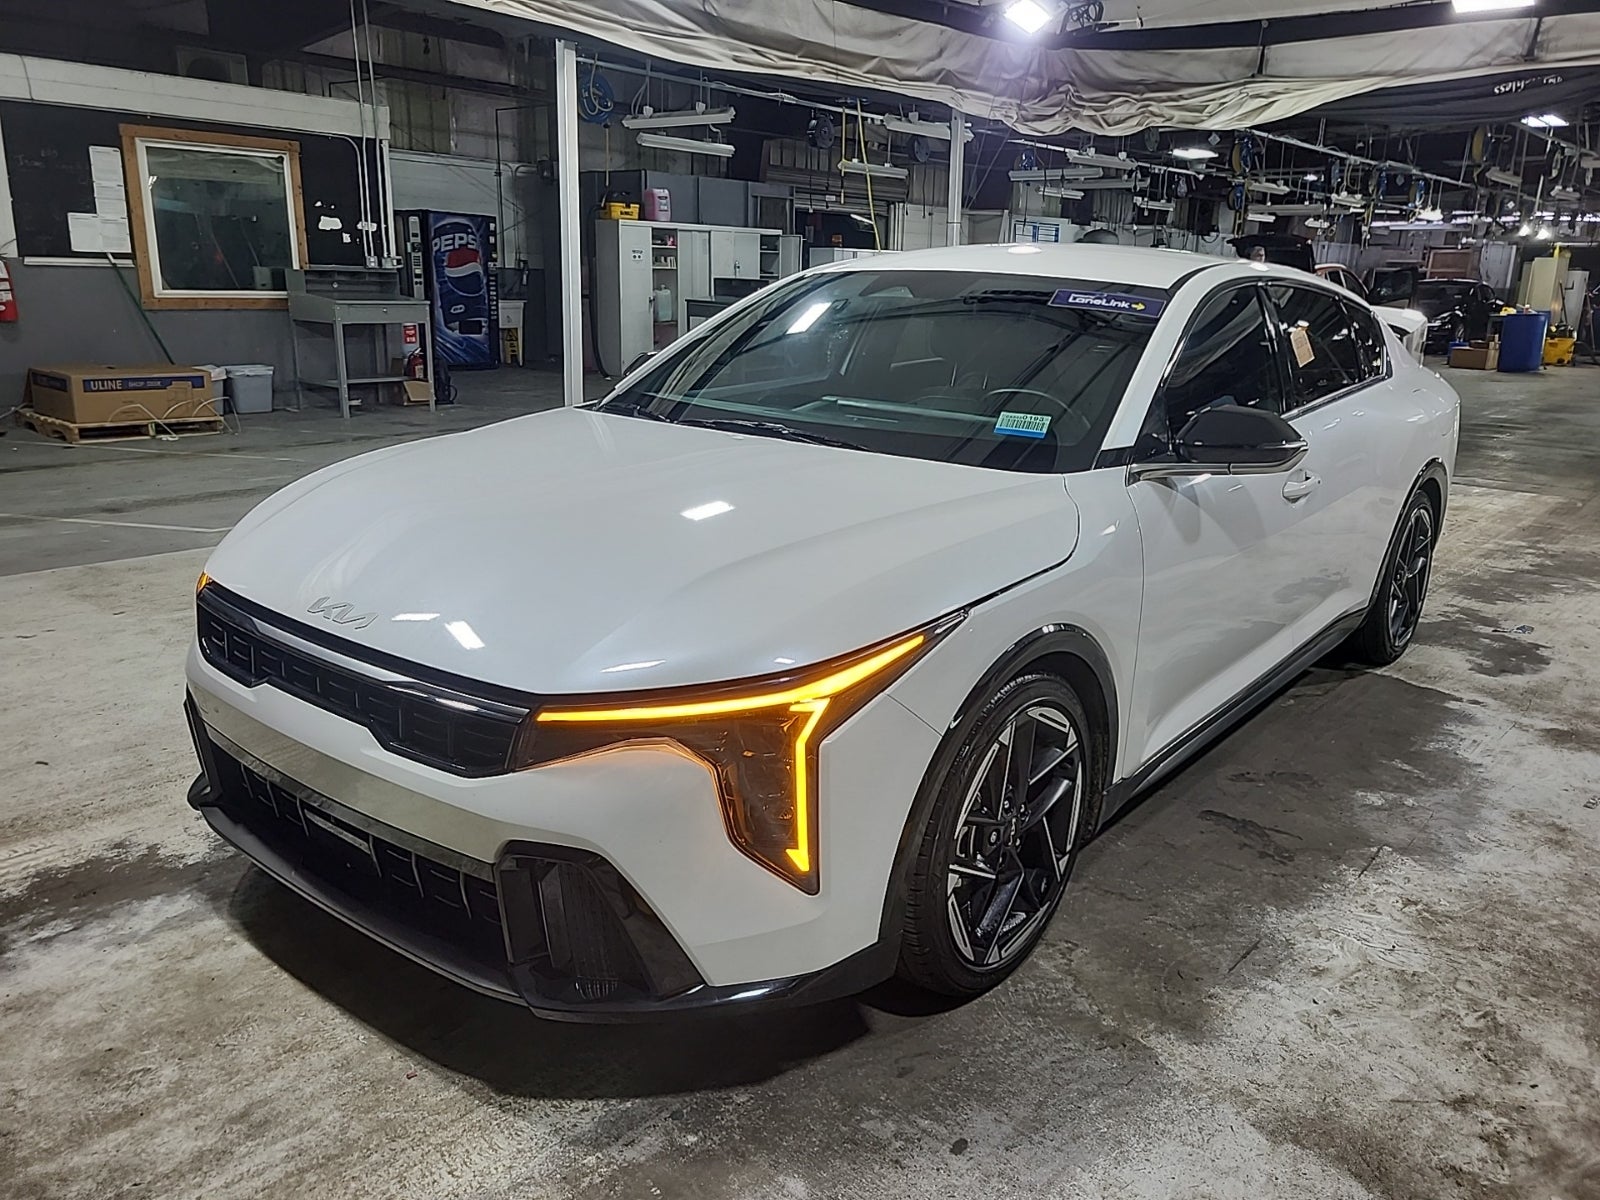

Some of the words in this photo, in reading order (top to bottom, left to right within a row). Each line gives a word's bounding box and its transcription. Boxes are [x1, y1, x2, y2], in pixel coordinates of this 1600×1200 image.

[432, 233, 479, 252] PEPS
[1068, 293, 1131, 309] LaneLink
[90, 379, 123, 391] ULINE
[306, 596, 379, 631] KIA
